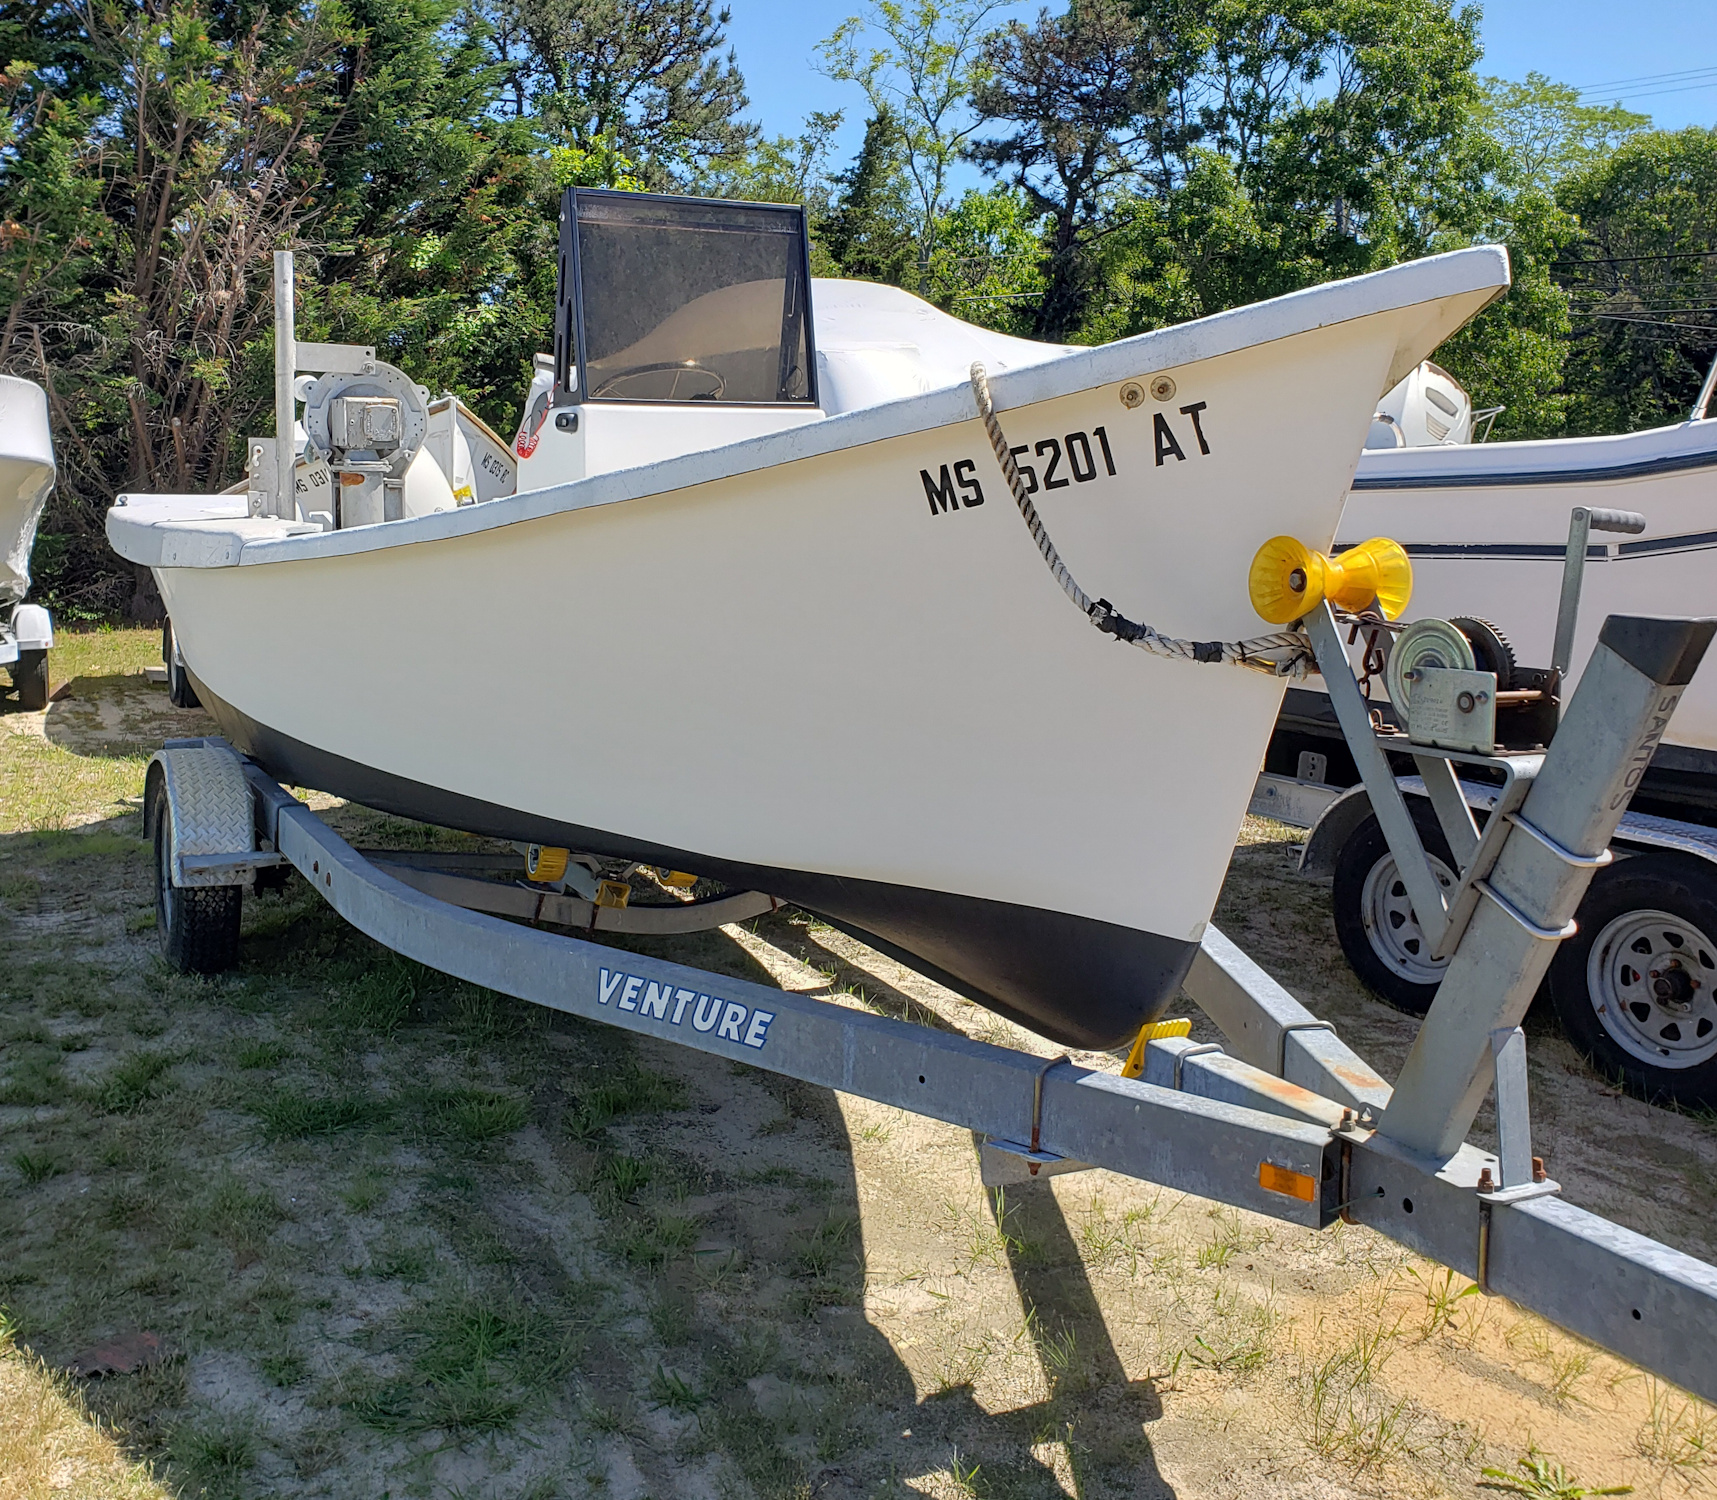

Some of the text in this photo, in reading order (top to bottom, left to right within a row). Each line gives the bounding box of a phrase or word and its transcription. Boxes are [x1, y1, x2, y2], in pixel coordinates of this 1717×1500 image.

[481, 452, 492, 469] MS
[919, 401, 1211, 516] MS 5201 AT
[1609, 695, 1677, 811] SANTOS
[597, 966, 776, 1050] VENTURE
